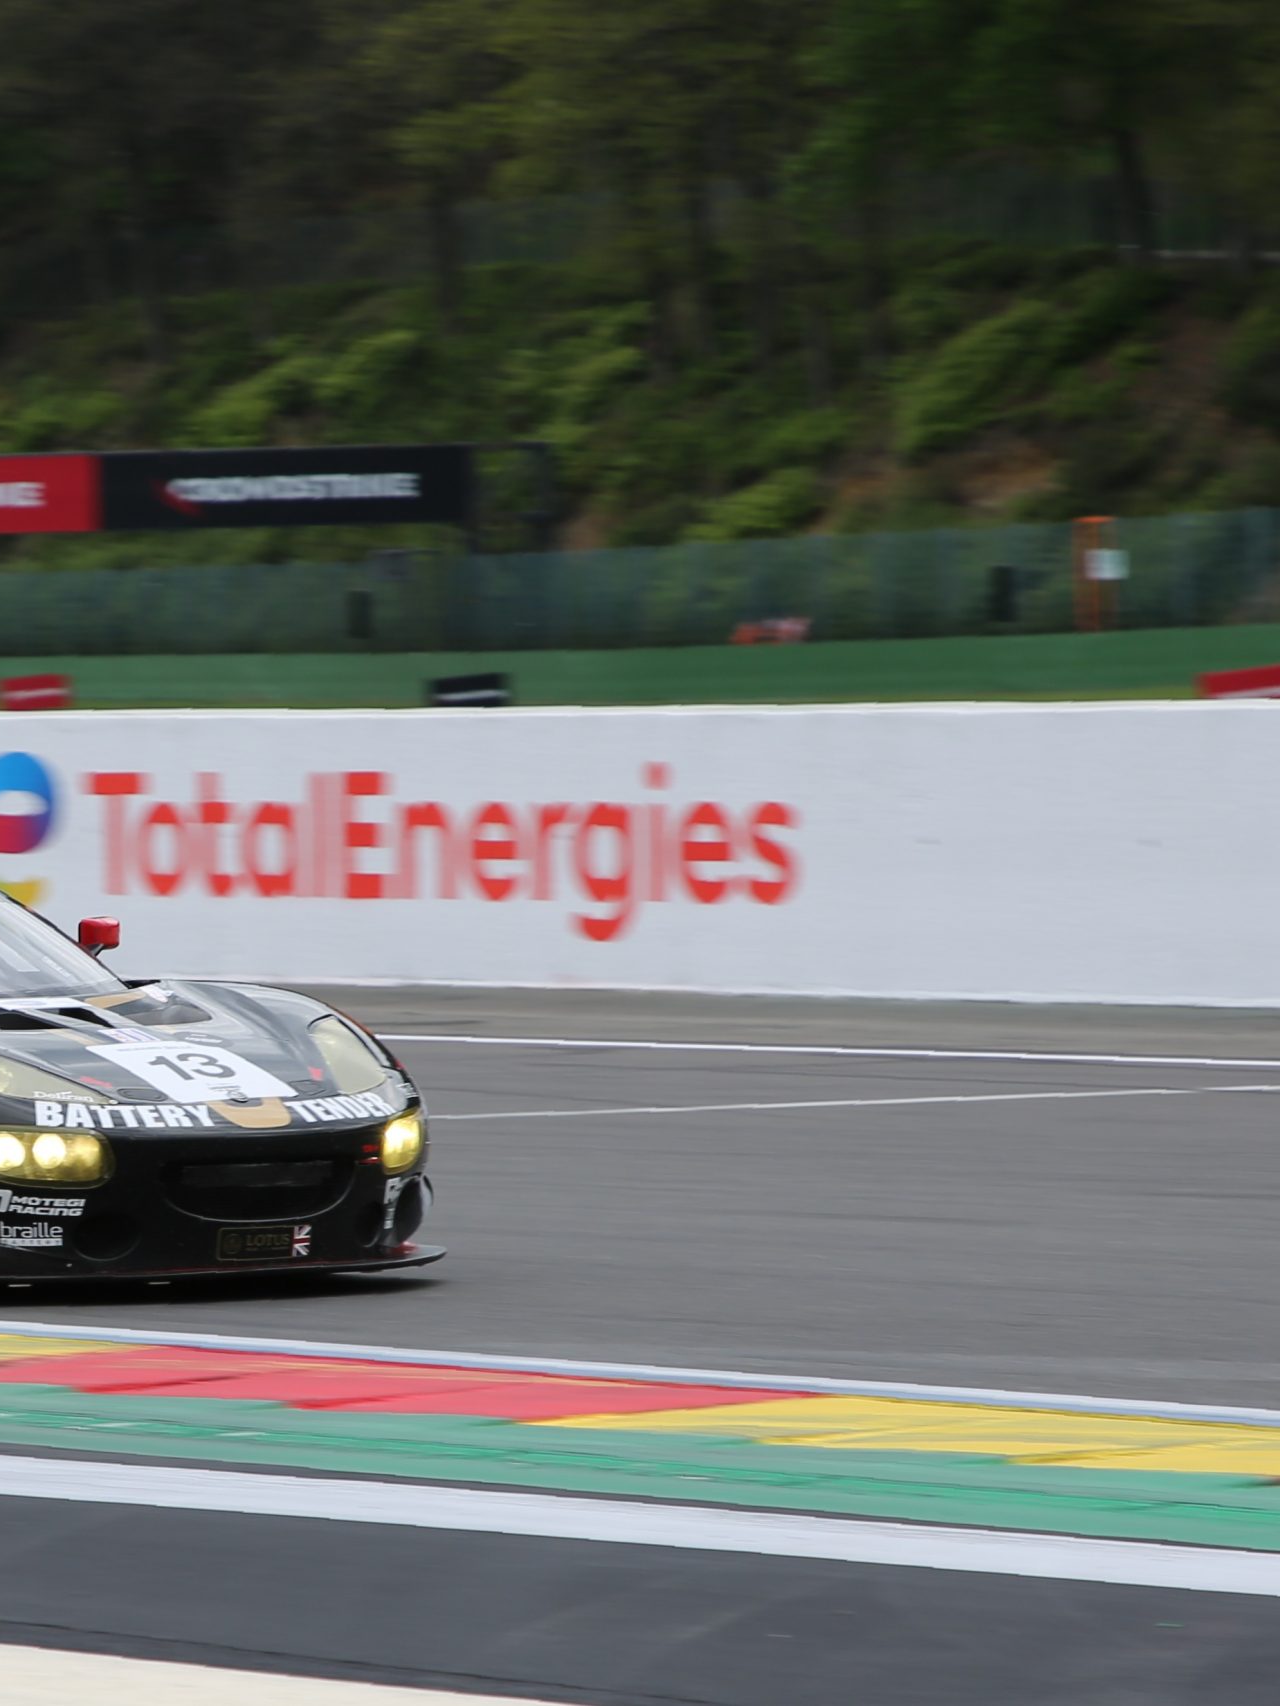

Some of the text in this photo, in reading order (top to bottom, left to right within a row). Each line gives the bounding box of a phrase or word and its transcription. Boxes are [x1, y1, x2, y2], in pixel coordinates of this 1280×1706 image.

[81, 762, 803, 941] TotalEnergies
[146, 1053, 236, 1081] 13
[34, 1092, 398, 1128] BATTERY TENDER
[8, 1204, 83, 1216] RACING
[10, 1196, 86, 1207] MOTEGI
[0, 1220, 63, 1238] braille
